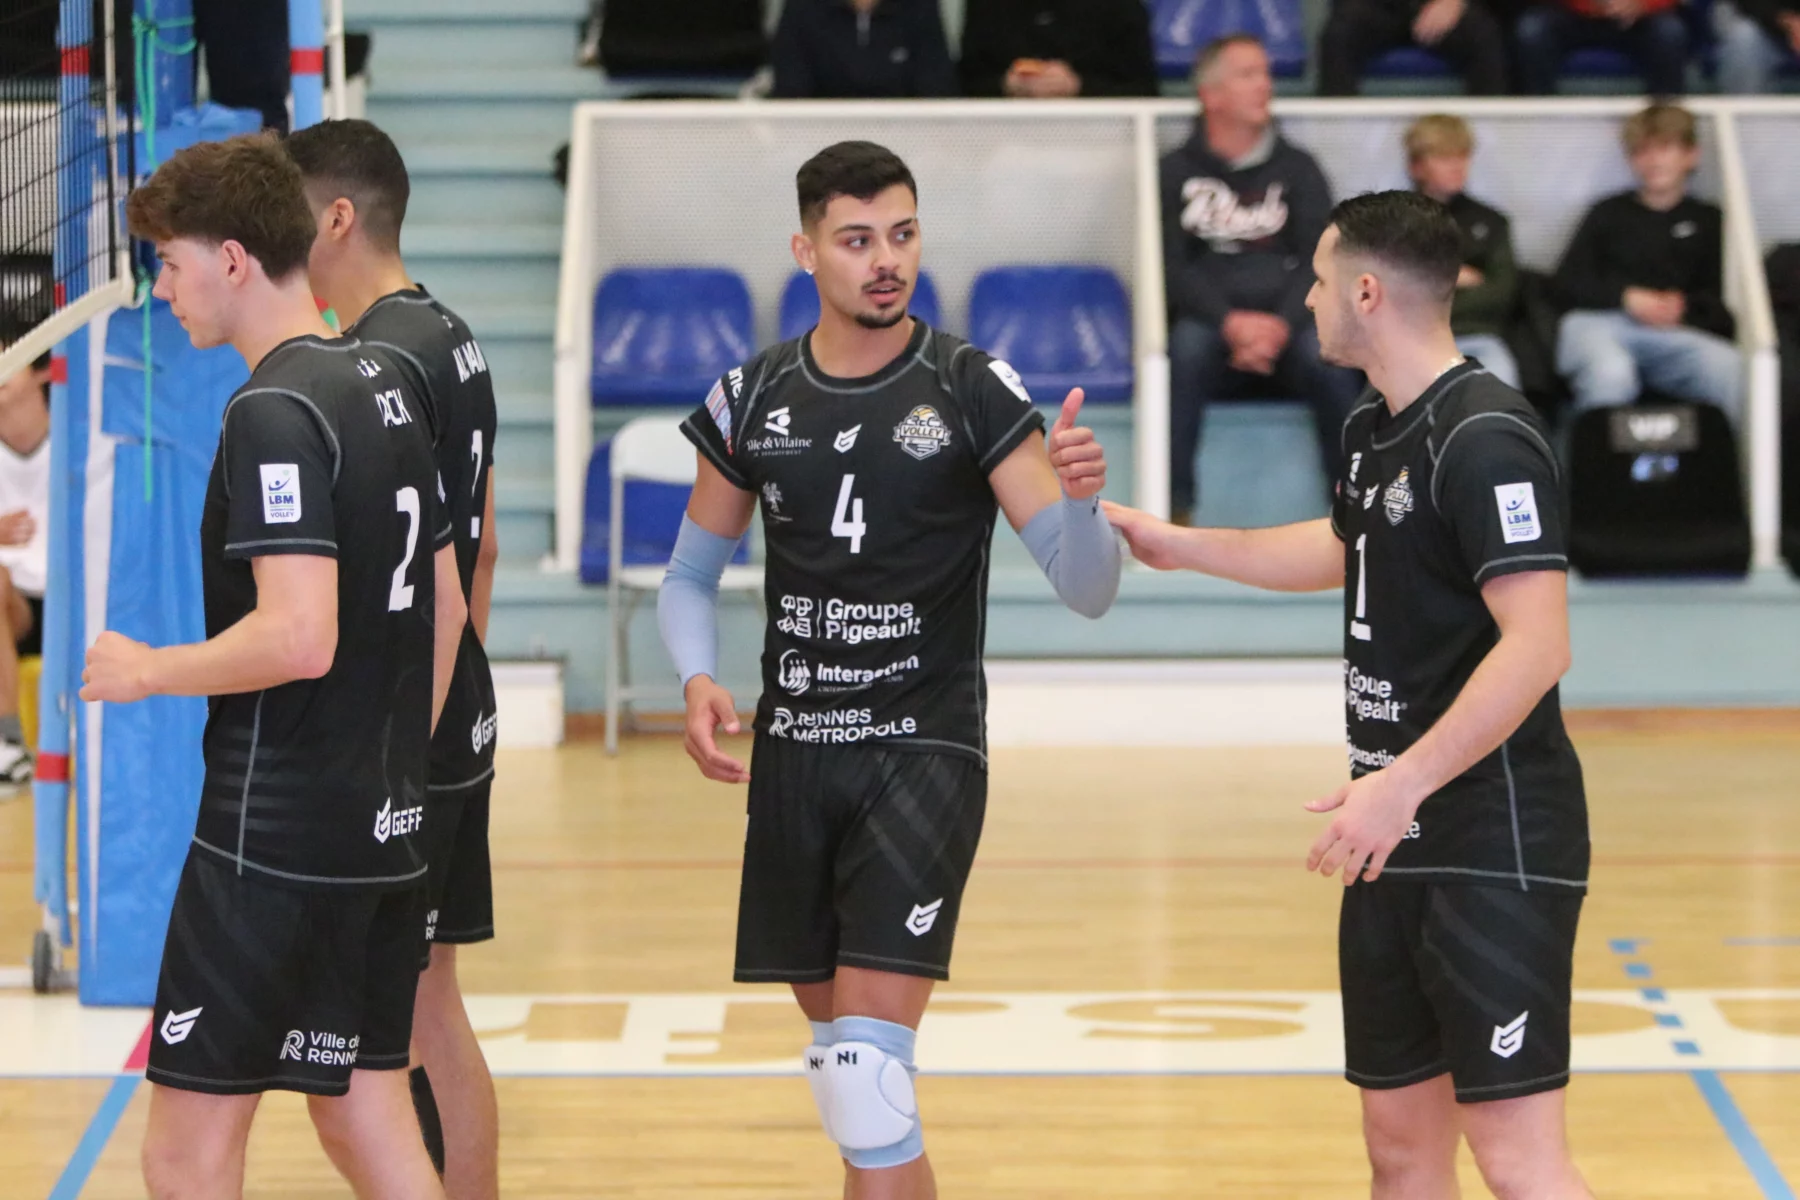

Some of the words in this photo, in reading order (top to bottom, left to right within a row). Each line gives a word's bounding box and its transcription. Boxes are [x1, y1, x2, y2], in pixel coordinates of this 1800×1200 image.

[903, 426, 942, 438] VOLLEY
[774, 436, 812, 449] Vilaine
[268, 495, 294, 505] LBM
[831, 474, 867, 553] 4
[1507, 513, 1532, 524] LBM
[388, 486, 420, 612] 2
[1350, 534, 1371, 641] 1
[826, 599, 914, 624] Groupe
[825, 617, 922, 645] Pigeault
[310, 1031, 346, 1049] Ville
[837, 1051, 857, 1065] N1
